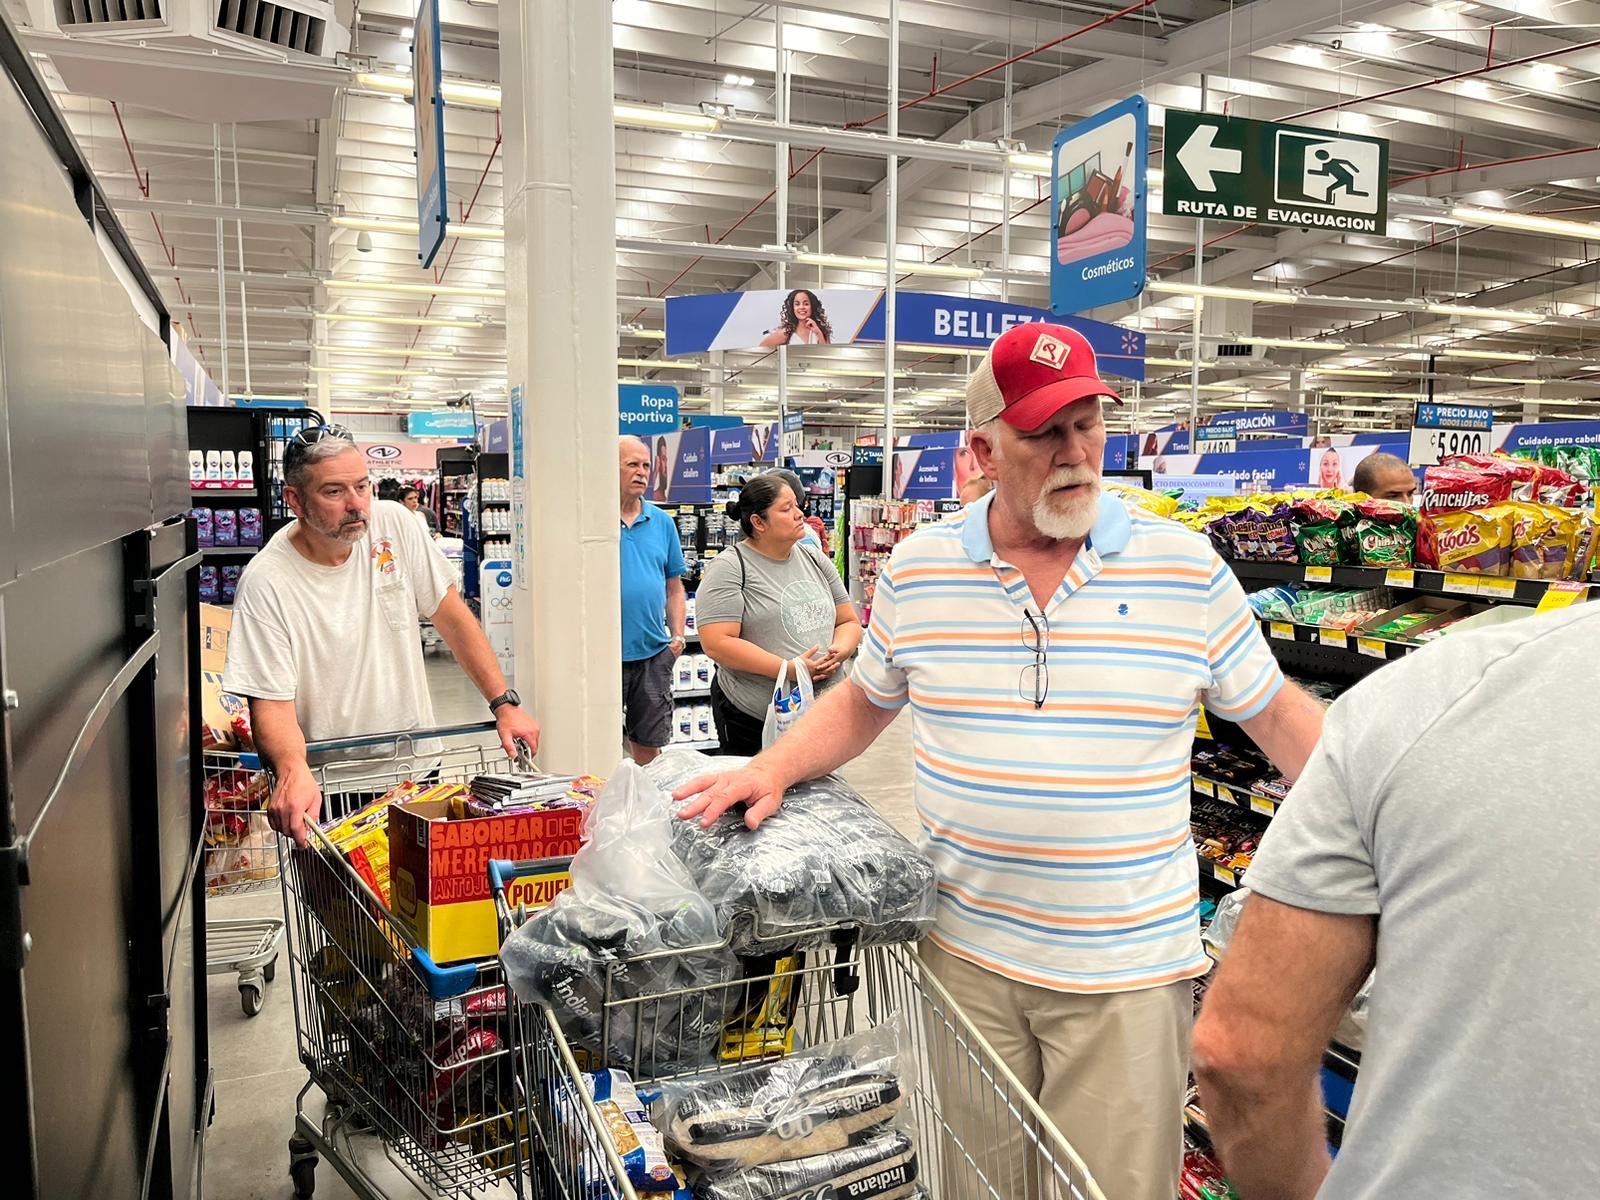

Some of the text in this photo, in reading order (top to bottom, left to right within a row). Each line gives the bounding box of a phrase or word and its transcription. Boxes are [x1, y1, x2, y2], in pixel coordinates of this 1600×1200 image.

[1177, 200, 1376, 232] RUTA DE EVACUACION
[1081, 254, 1135, 282] Cosméticos
[934, 308, 1046, 340] BELLE
[641, 395, 674, 410] Ropa
[1436, 407, 1489, 419] PRECIO BAJO
[619, 411, 674, 427] eportiva
[1518, 436, 1553, 446] Cuidado
[1554, 437, 1573, 447] para
[1252, 468, 1276, 481] facial
[431, 817, 543, 849] SABOREAR
[431, 841, 543, 877] MERENDAR
[826, 1090, 881, 1115] Indiana
[849, 1166, 907, 1196] Indiana
